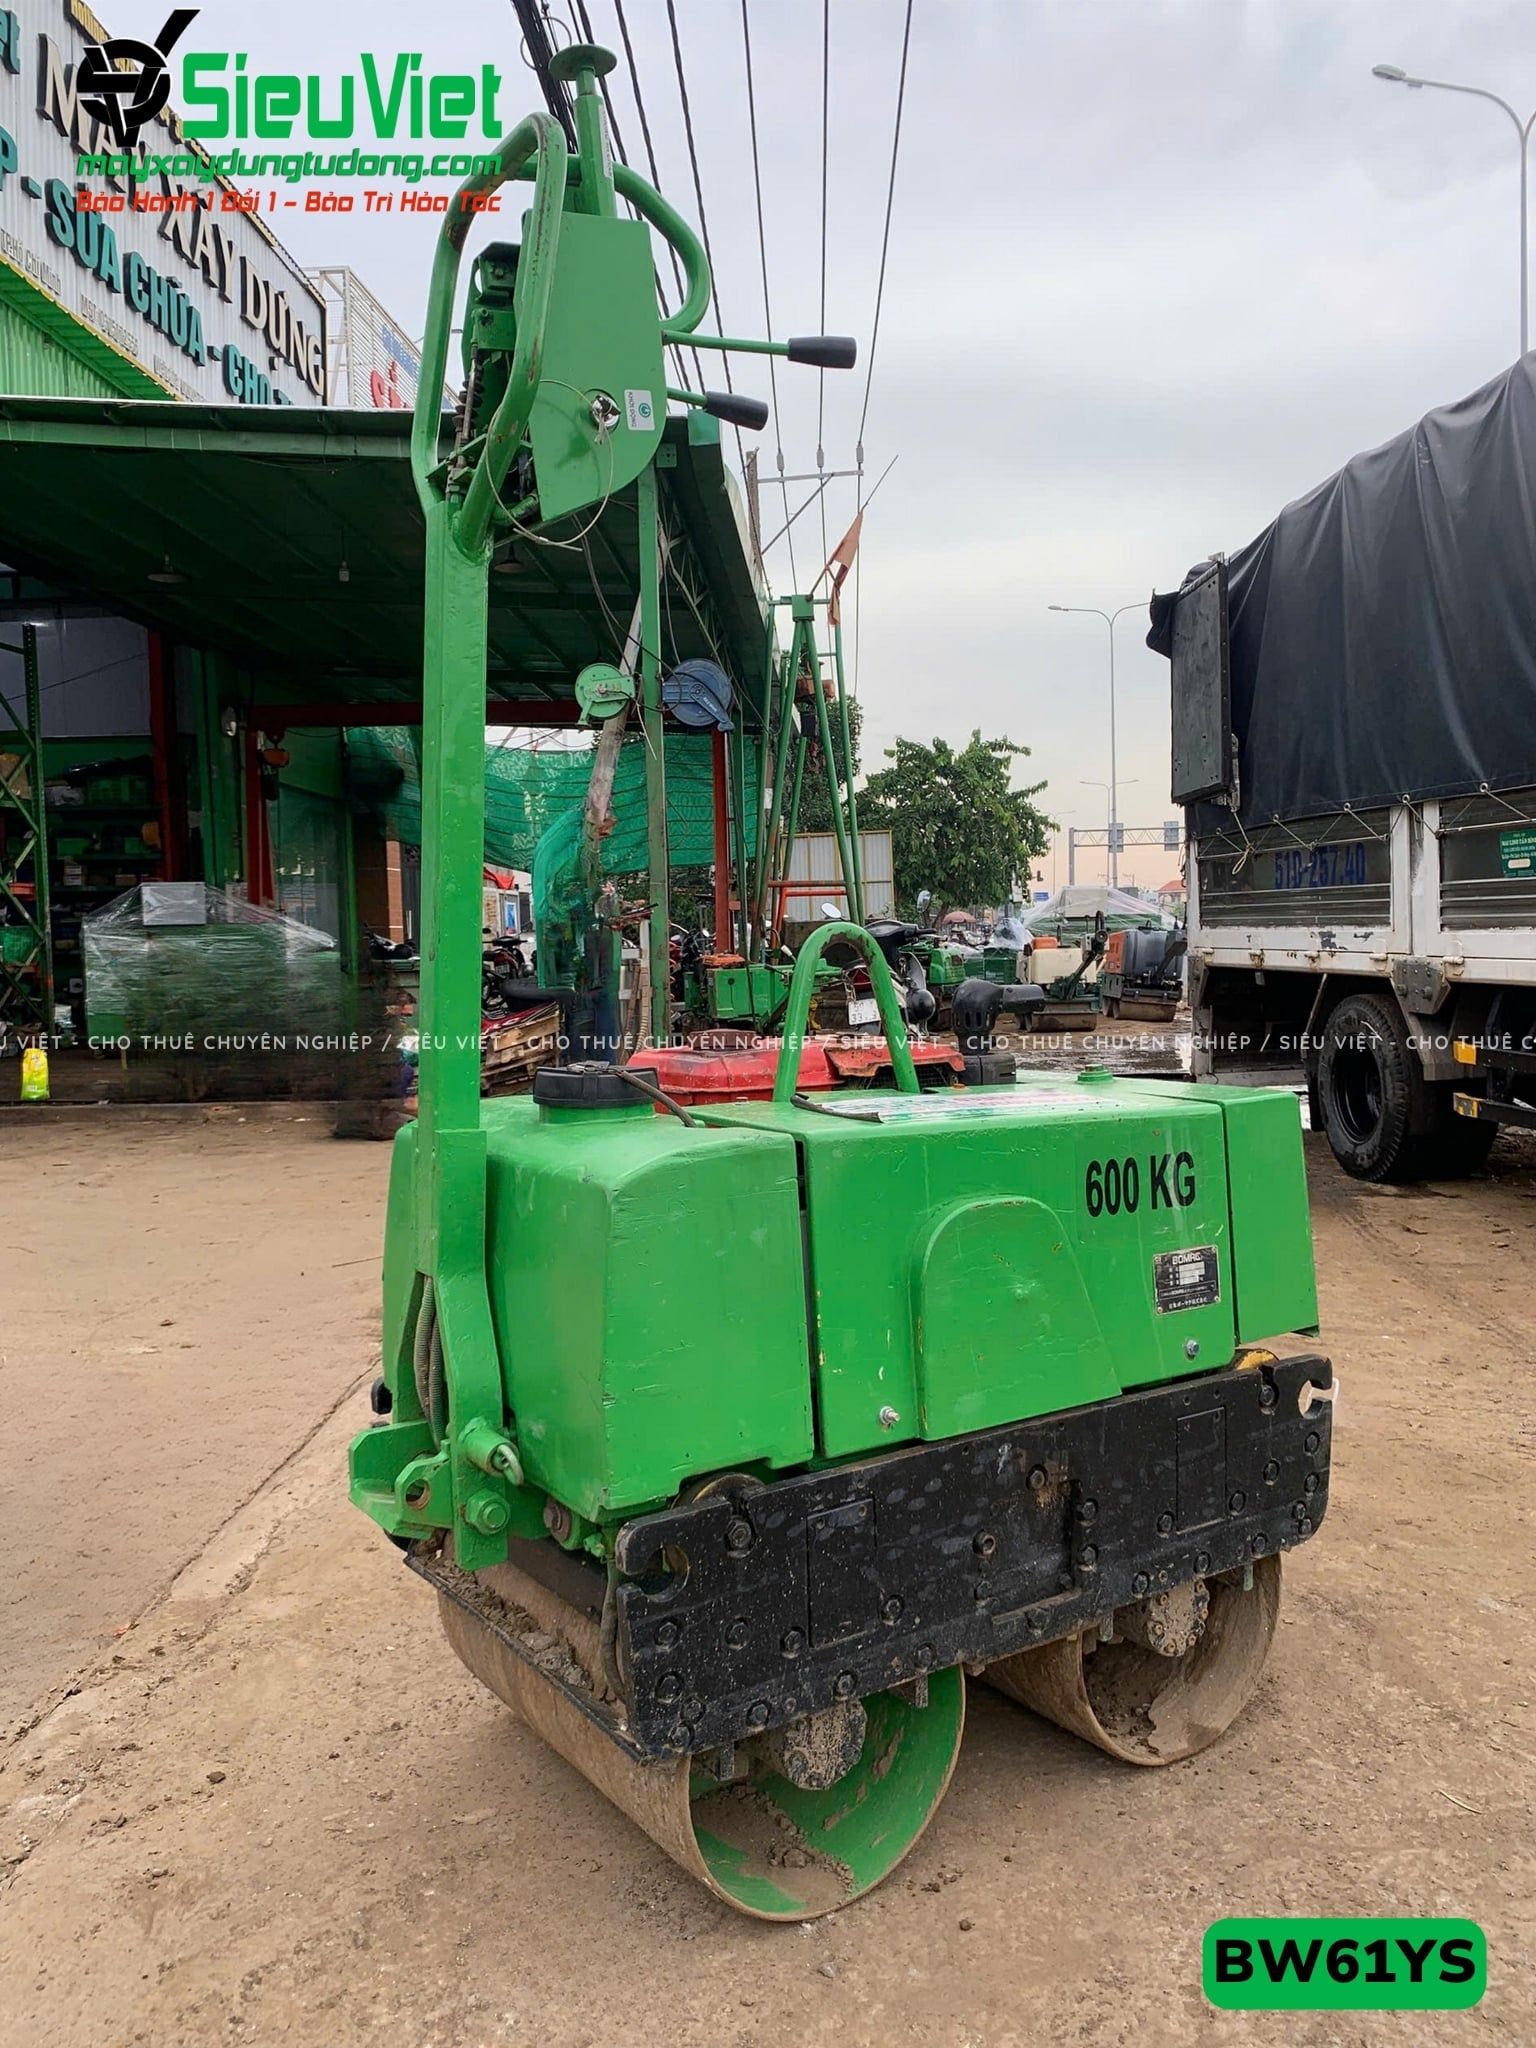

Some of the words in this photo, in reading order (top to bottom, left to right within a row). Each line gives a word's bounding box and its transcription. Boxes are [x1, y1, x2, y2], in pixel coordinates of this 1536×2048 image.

[123, 251, 206, 366] CHỮA
[240, 256, 325, 396] DỰNG
[1085, 1157, 1140, 1217] 600
[1150, 1151, 1196, 1210] KG
